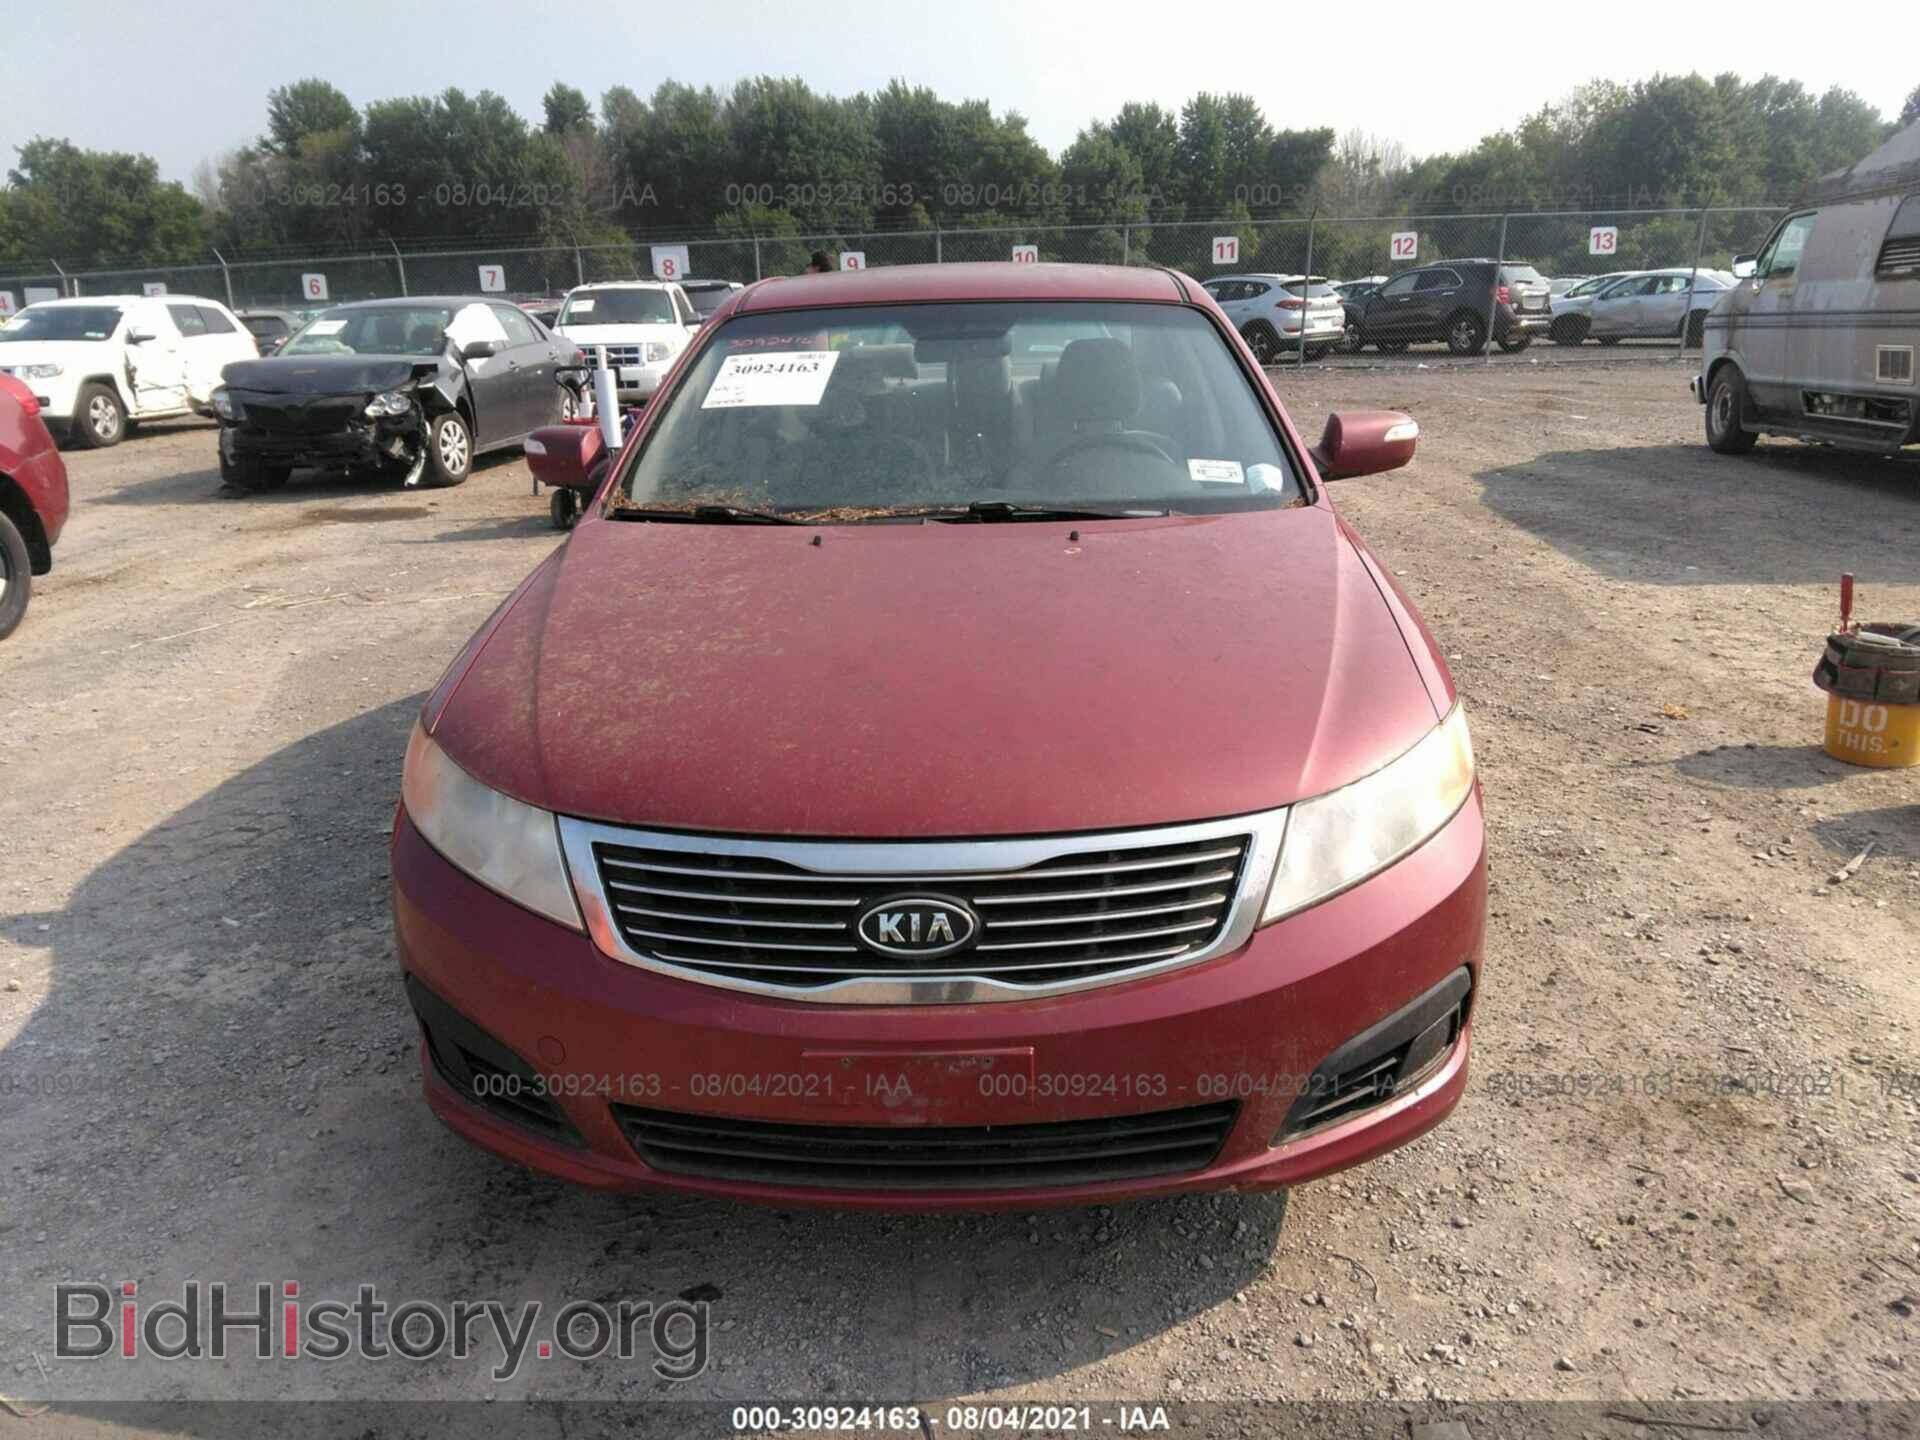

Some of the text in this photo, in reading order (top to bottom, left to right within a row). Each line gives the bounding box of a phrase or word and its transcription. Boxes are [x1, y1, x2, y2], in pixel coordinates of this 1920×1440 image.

[1216, 241, 1235, 260] 11
[1393, 237, 1414, 256] 12
[1592, 232, 1613, 251] 13
[848, 257, 858, 270] 9
[1015, 252, 1035, 263] 10
[662, 259, 675, 276] 8
[309, 278, 321, 296] 6
[486, 270, 497, 288] 7
[728, 361, 820, 376] 30924163
[1839, 699, 1889, 733] DO
[878, 912, 955, 943] KIA
